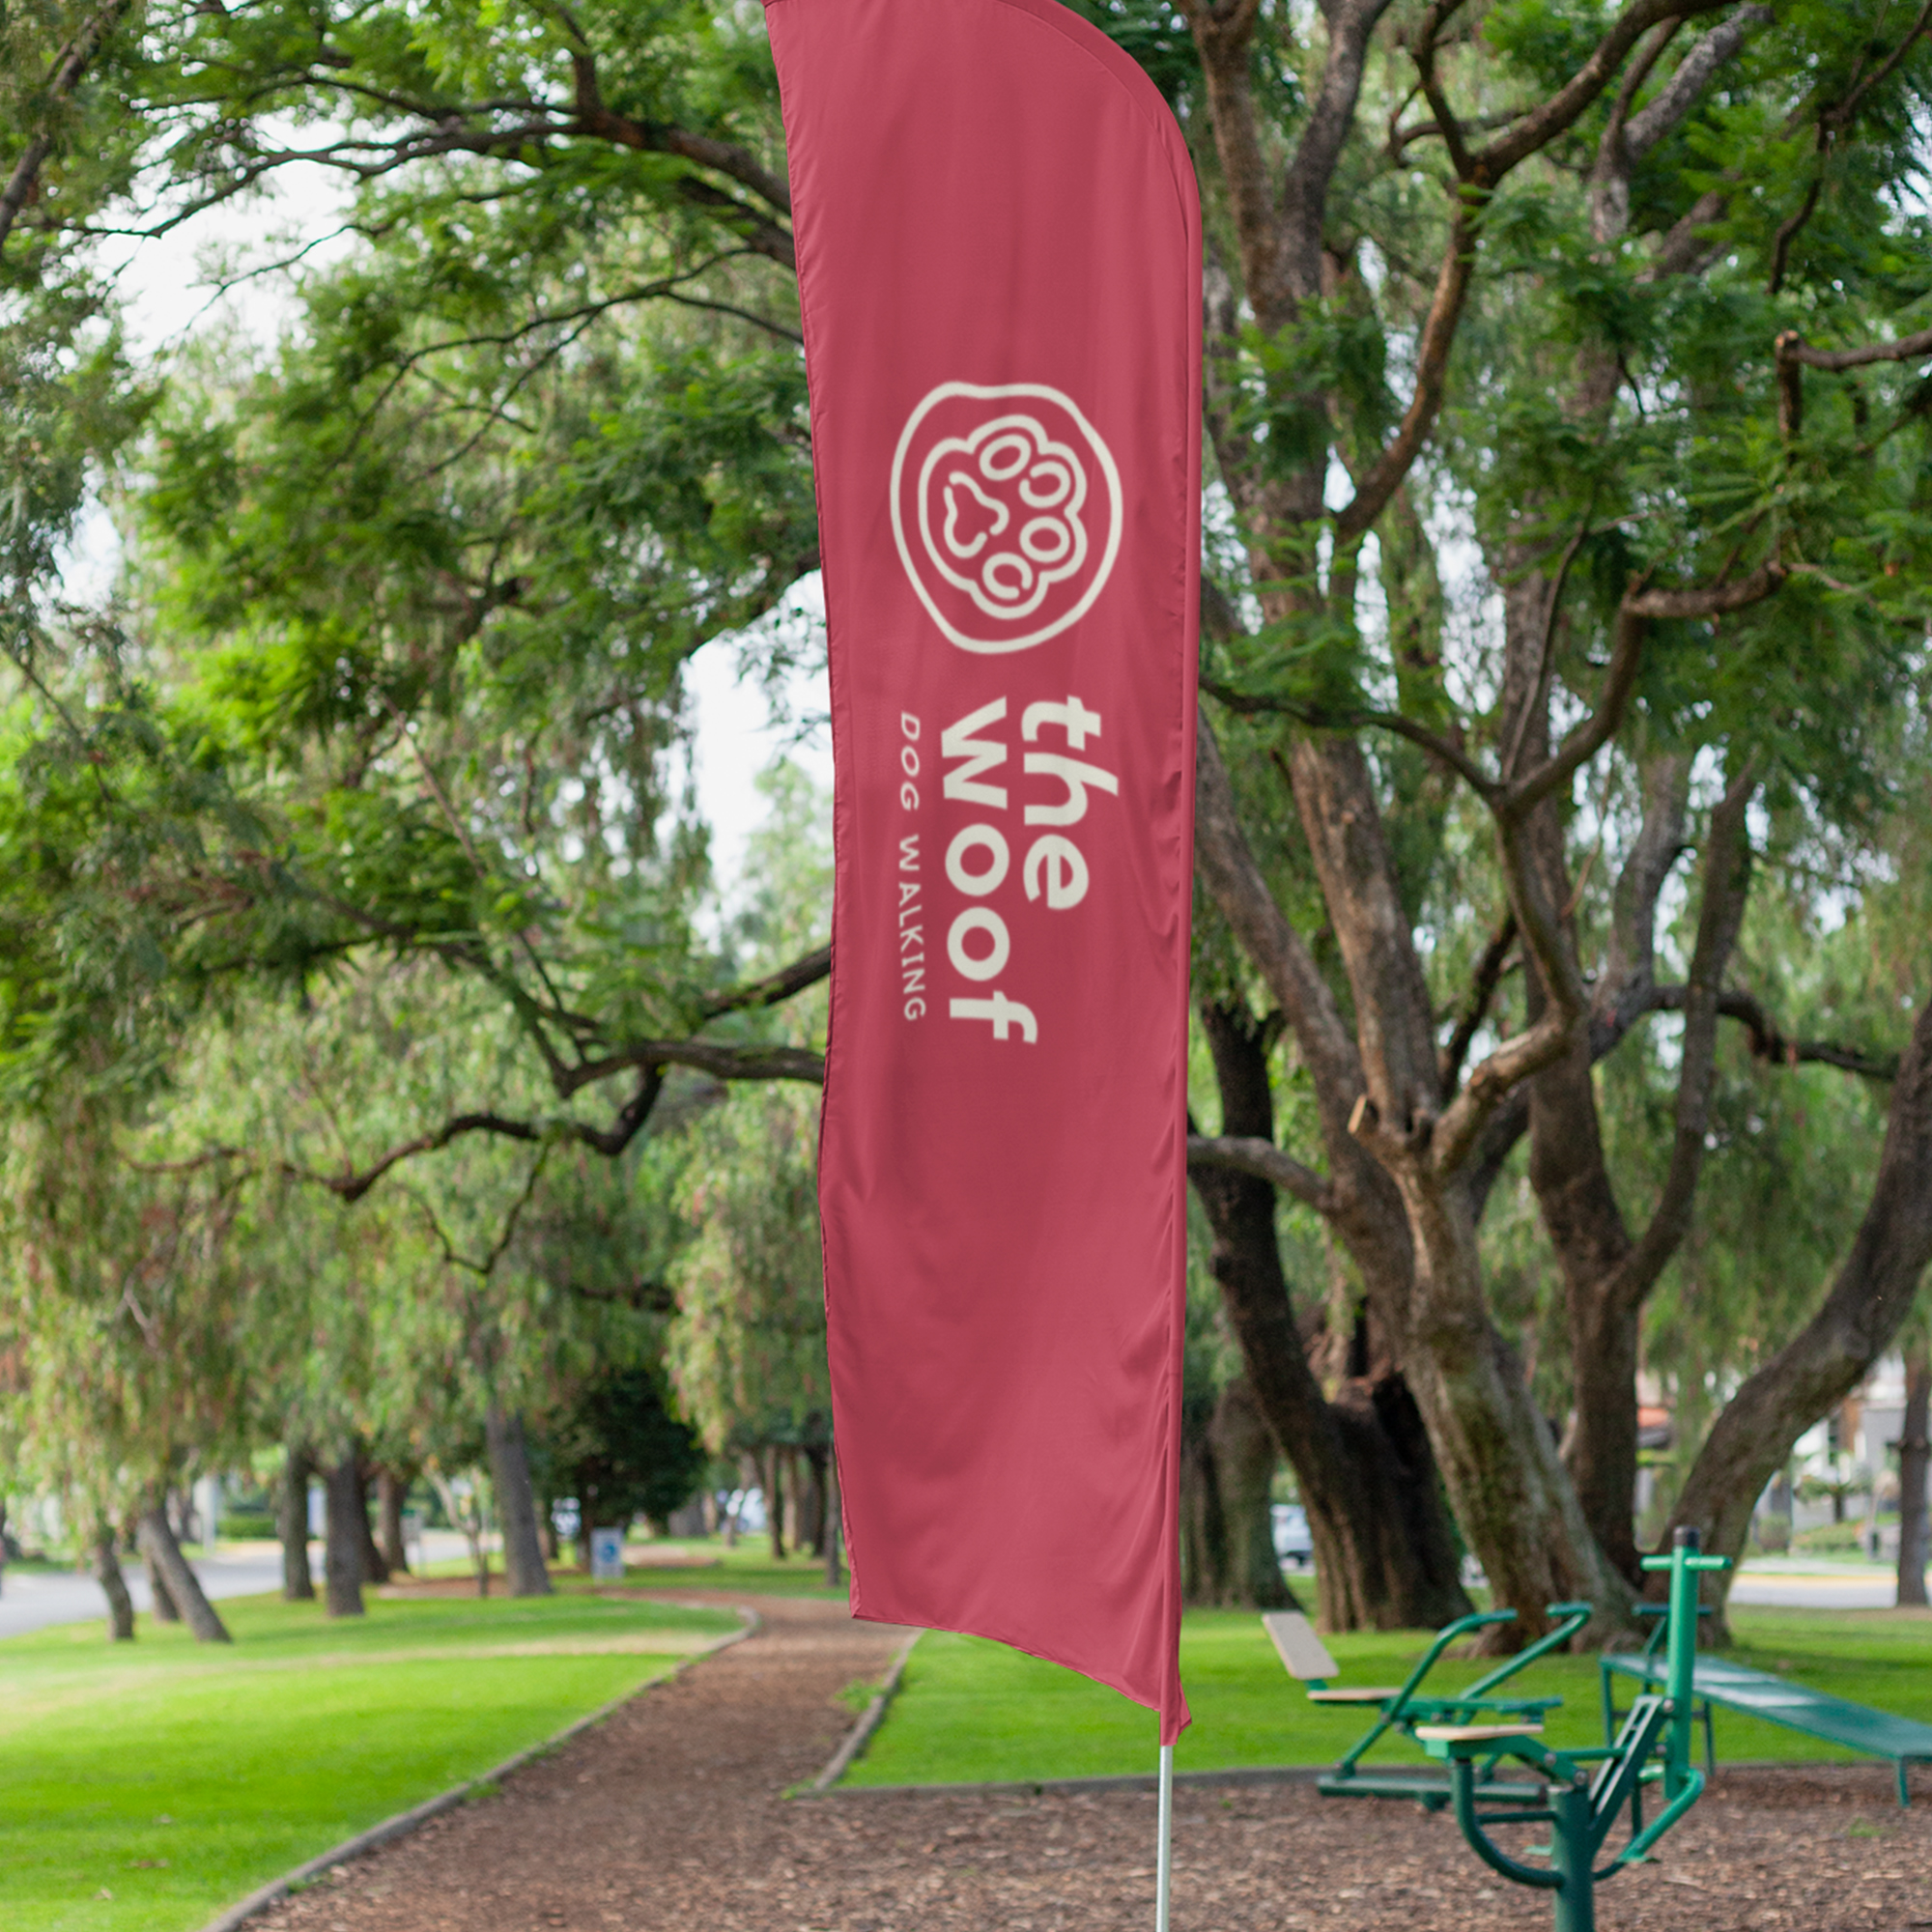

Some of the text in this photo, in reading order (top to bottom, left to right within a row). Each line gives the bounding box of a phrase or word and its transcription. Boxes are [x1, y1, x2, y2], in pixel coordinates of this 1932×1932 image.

[898, 711, 926, 1021] DOG WALKING
[940, 696, 1038, 1044] woof
[1021, 695, 1120, 910] the
